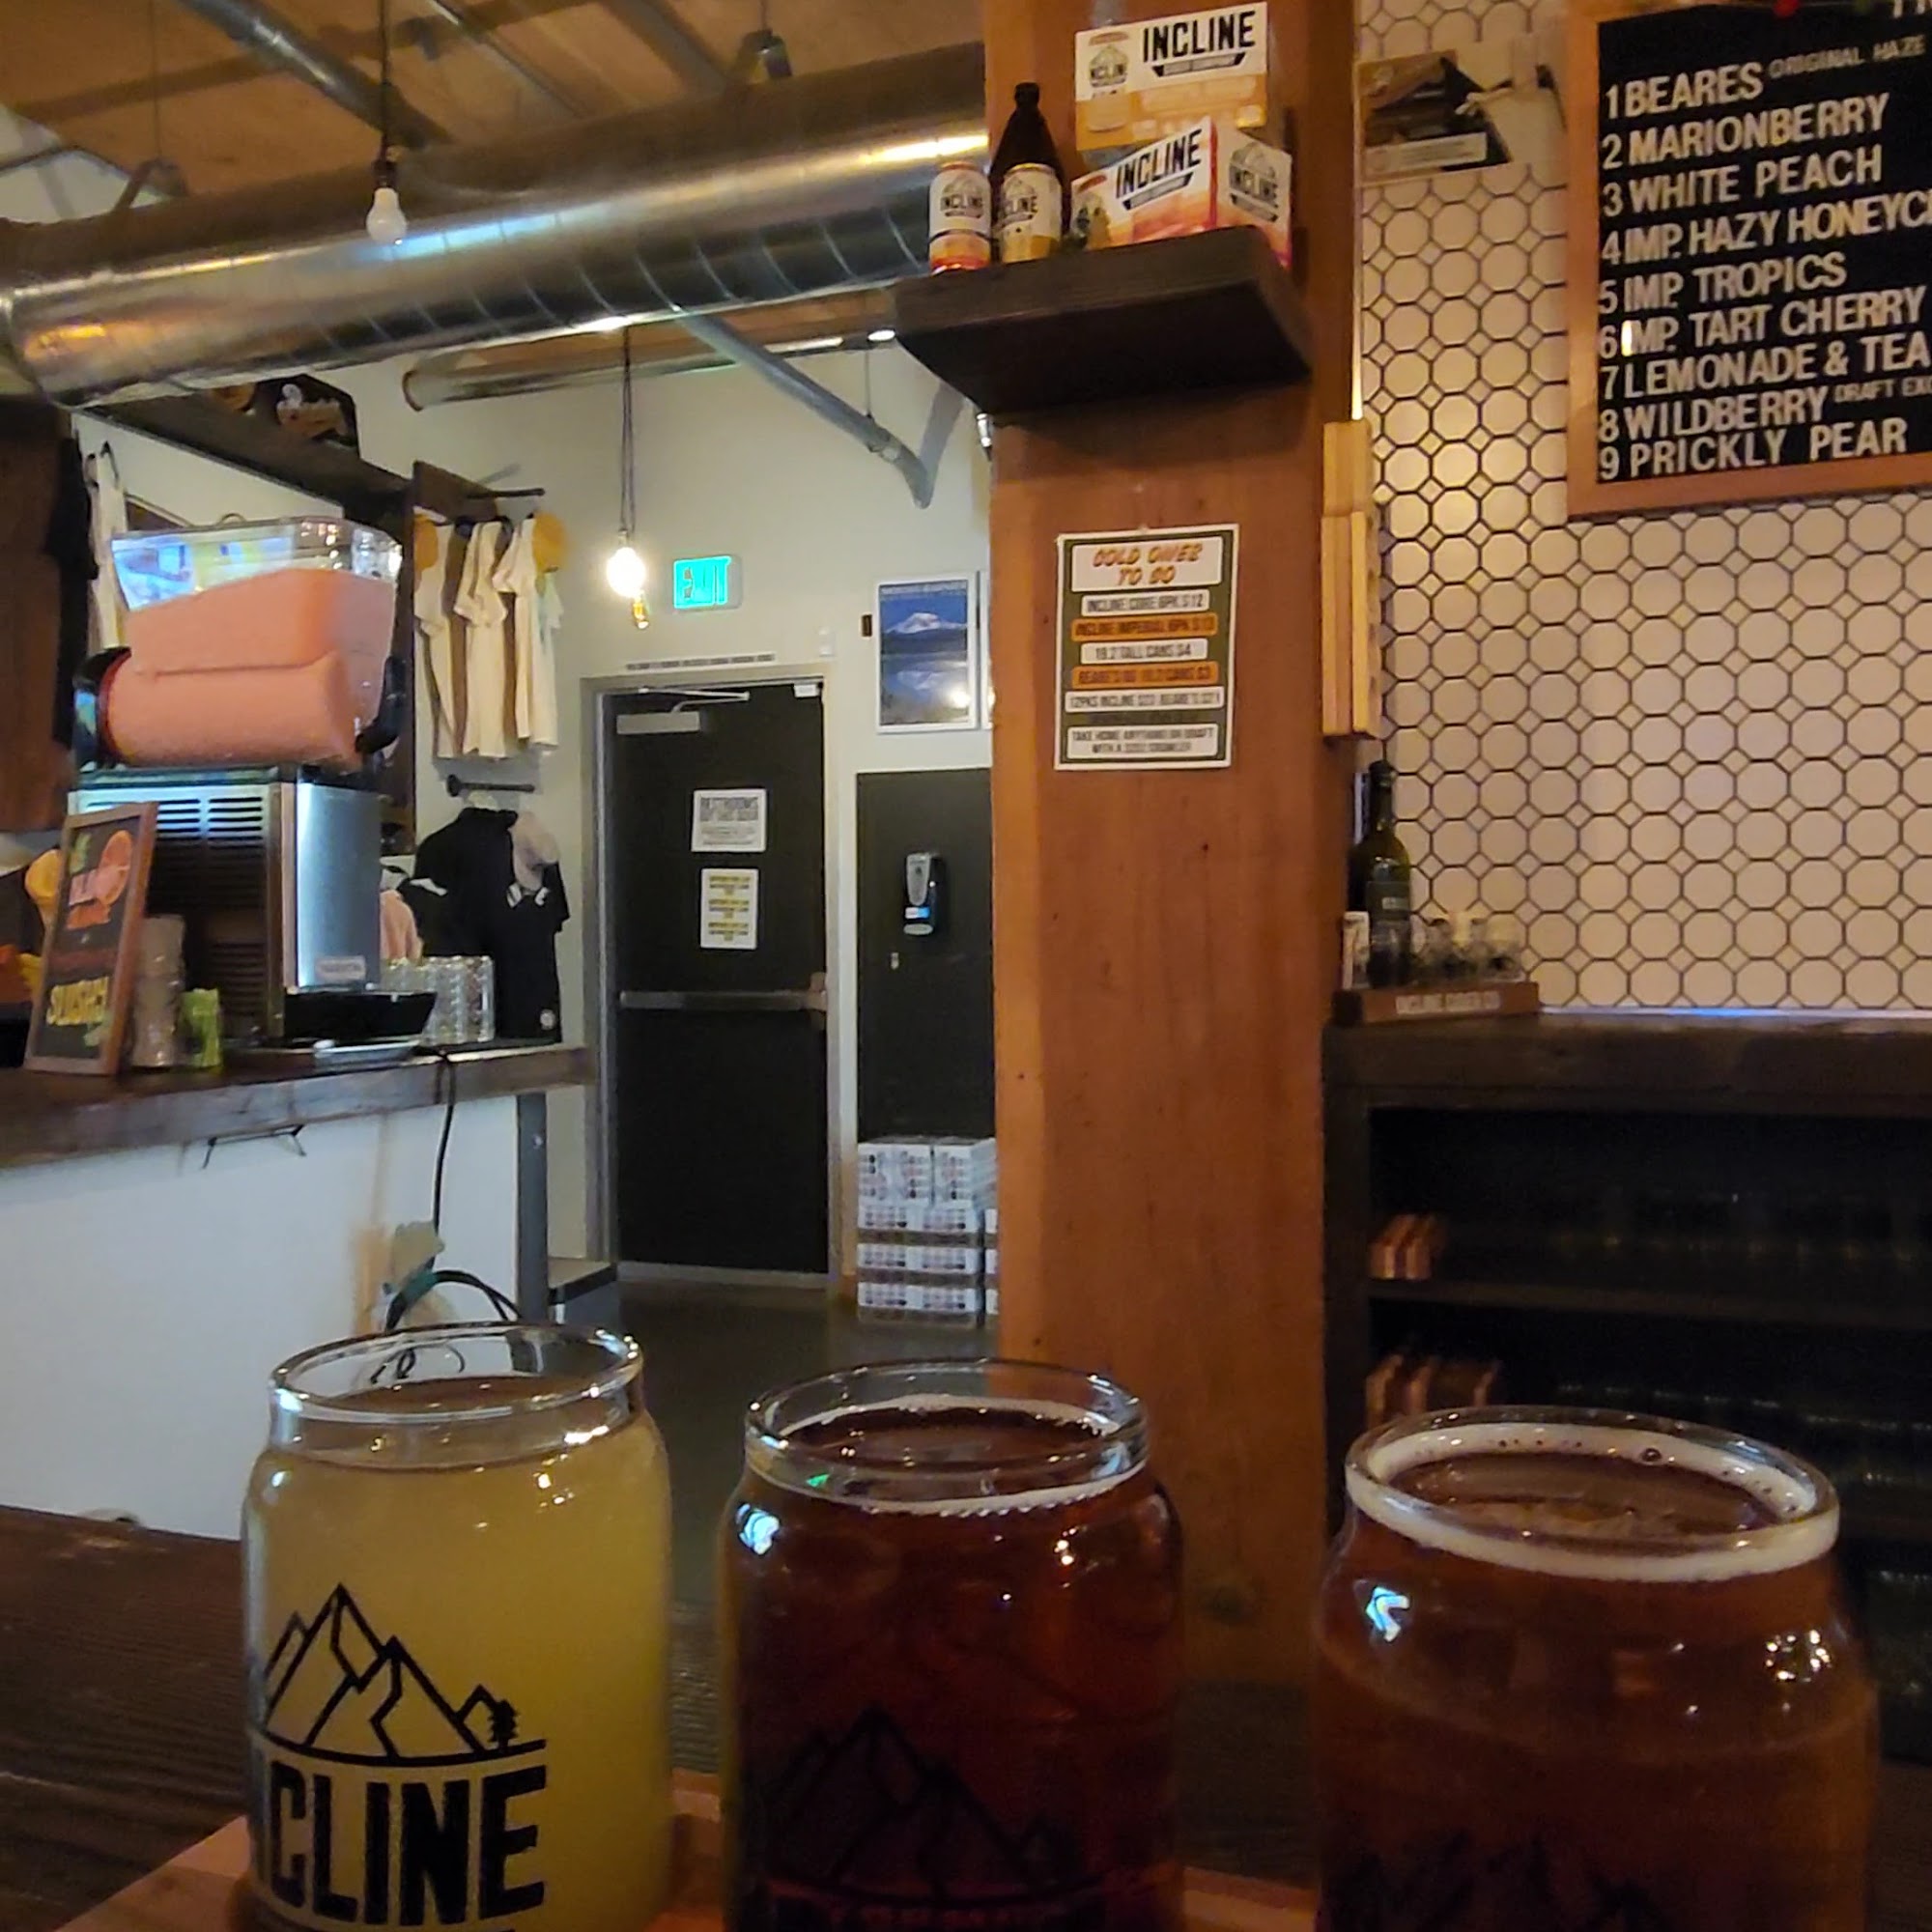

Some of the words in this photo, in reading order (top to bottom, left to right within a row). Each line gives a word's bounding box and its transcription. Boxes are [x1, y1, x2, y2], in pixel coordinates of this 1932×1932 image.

[1143, 11, 1256, 63] INCLINE
[1605, 84, 1619, 119] 1
[1625, 62, 1764, 118] BEARES
[1602, 134, 1622, 169] 2
[1629, 93, 1889, 166] MARIONBERRY
[1116, 128, 1202, 199] INCLINE
[1603, 183, 1624, 217] 3
[1629, 165, 1740, 213] WHITE
[1754, 144, 1882, 199] PEACH
[1602, 231, 1621, 265] 4
[1690, 209, 1781, 255] HAZY
[1599, 279, 1619, 314] 5
[1692, 251, 1848, 303] TROPICS
[1600, 325, 1618, 359] 6
[1689, 304, 1773, 348] TART
[1780, 285, 1927, 337] CHERRY
[1600, 365, 1619, 401] 7
[1624, 343, 1817, 398] LEMONADE
[1823, 340, 1849, 377] &
[1861, 330, 1931, 374] TEA
[1599, 408, 1620, 442] 8
[1624, 385, 1829, 440] WILDBERRY
[1600, 446, 1620, 481] 9
[1629, 428, 1787, 479] PRICKLY
[1809, 416, 1908, 462] PEAR
[673, 555, 731, 609] EXIT
